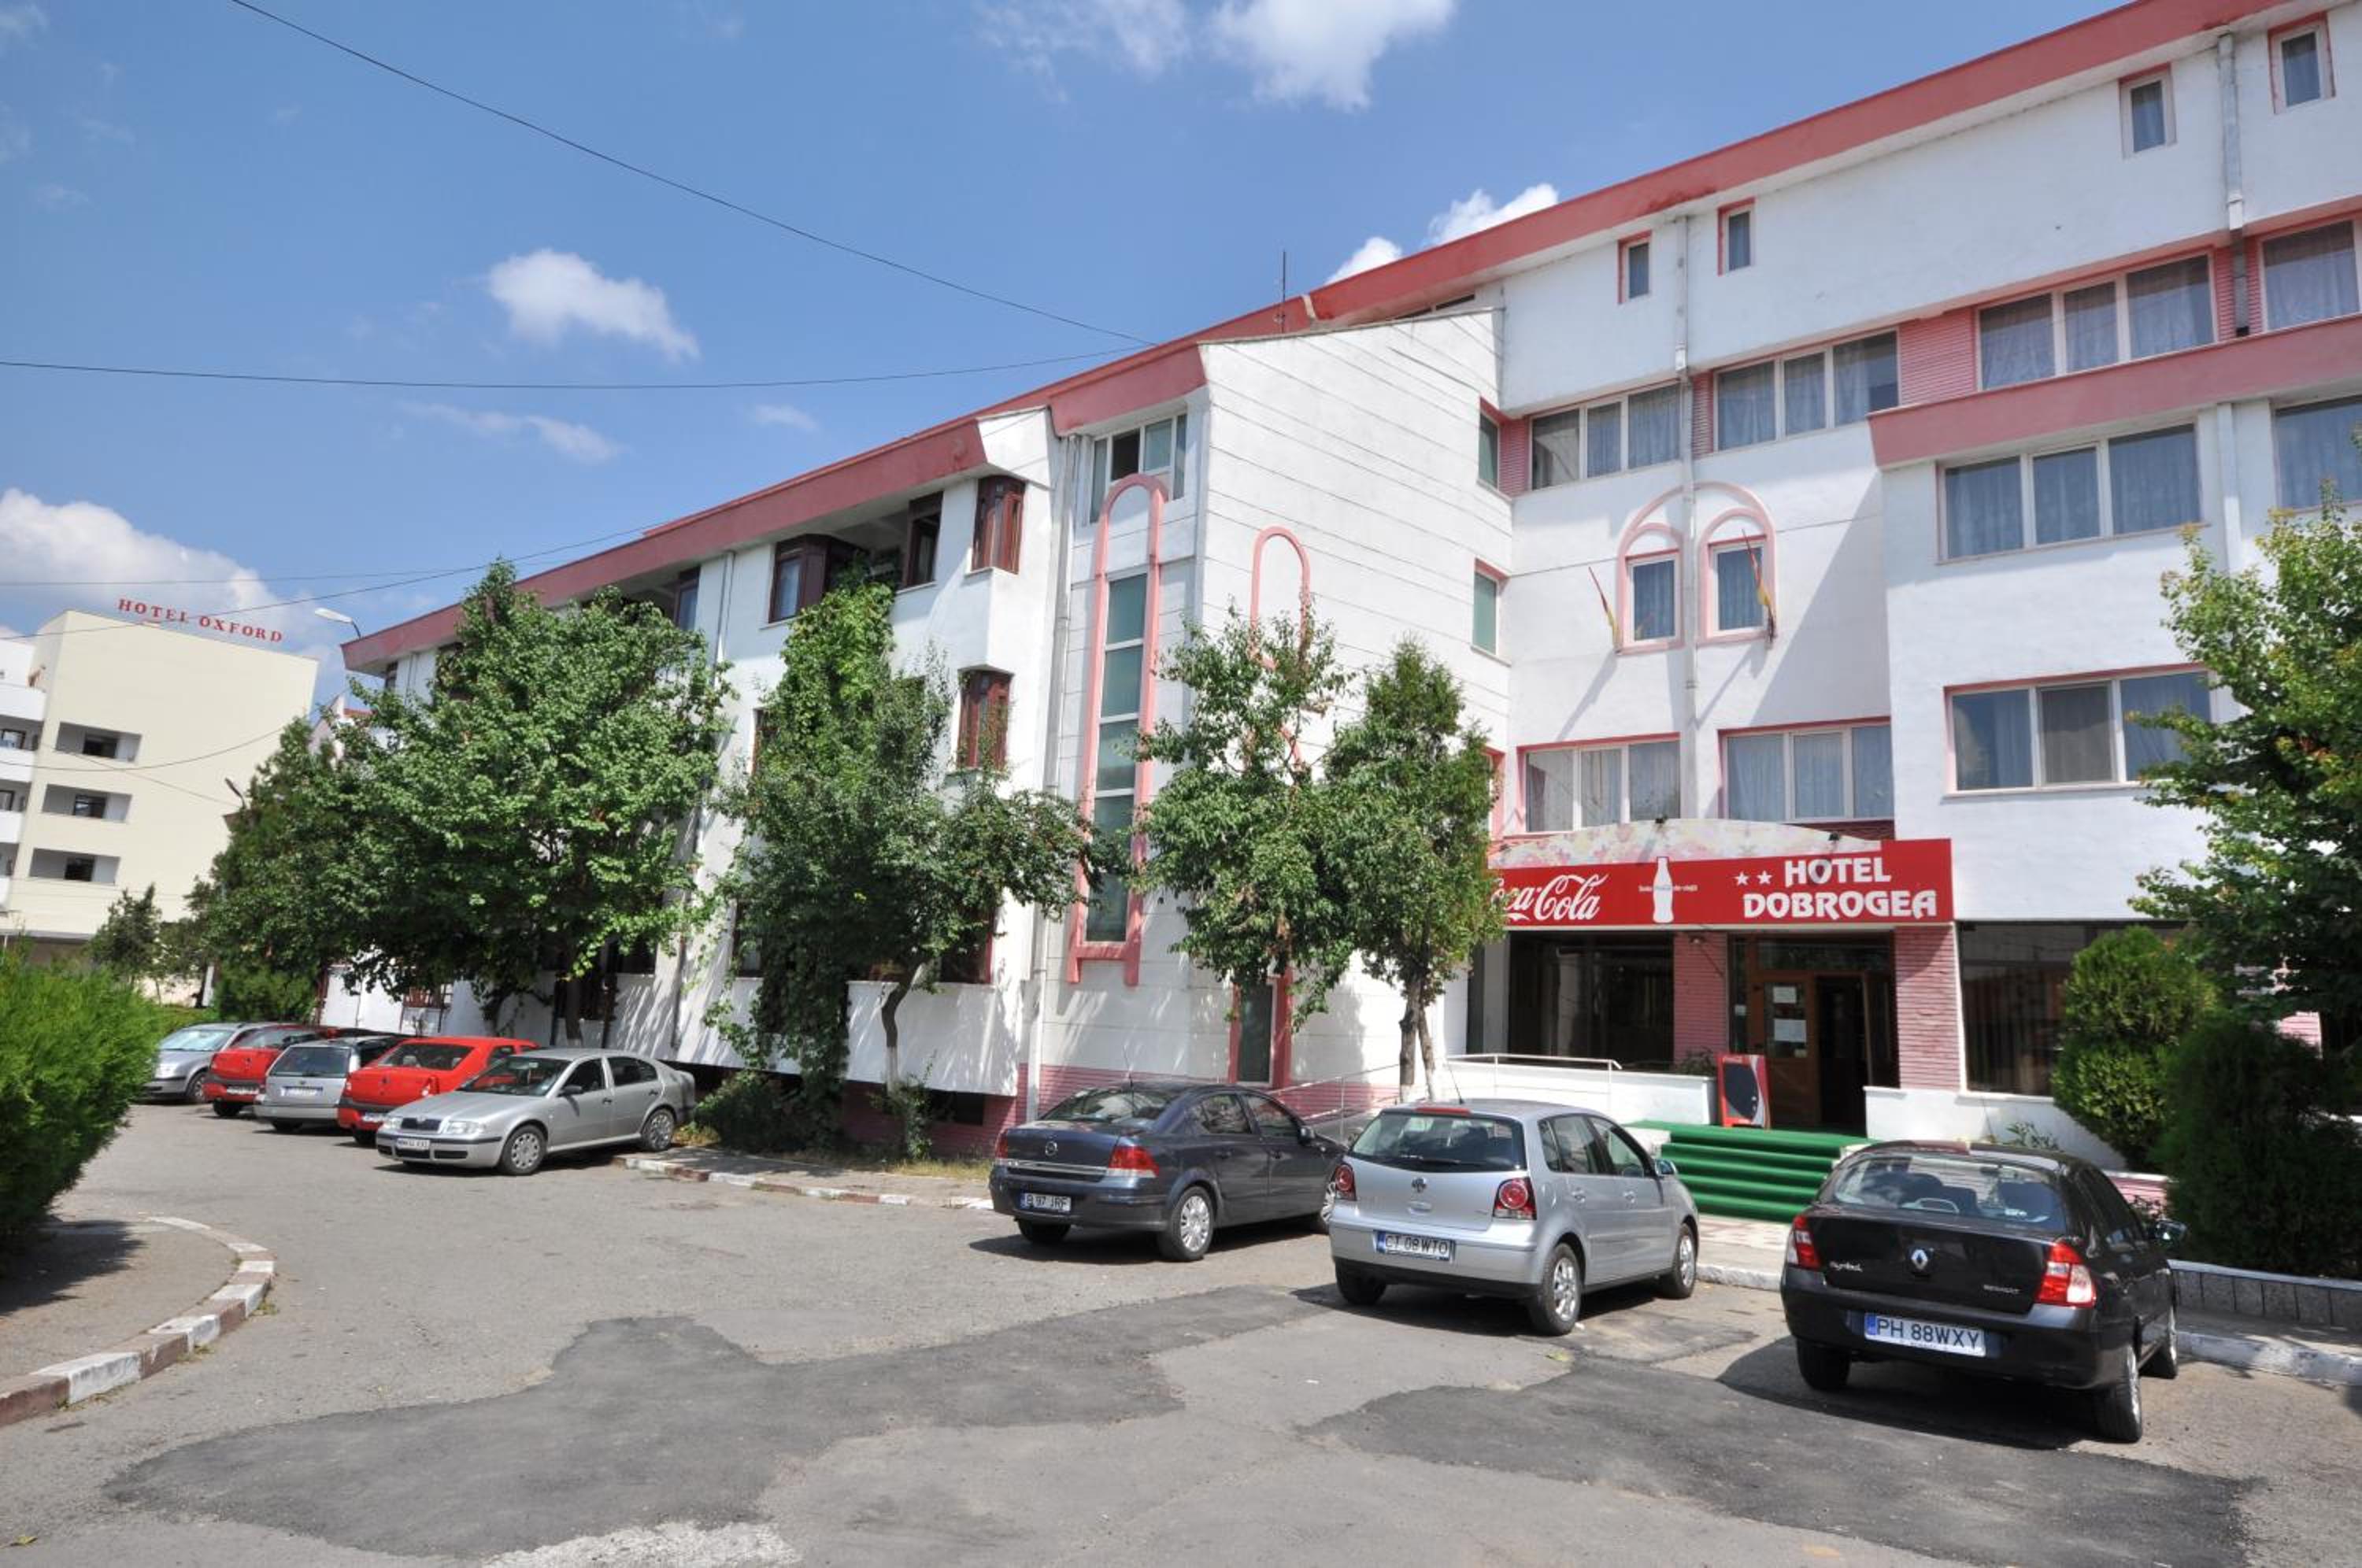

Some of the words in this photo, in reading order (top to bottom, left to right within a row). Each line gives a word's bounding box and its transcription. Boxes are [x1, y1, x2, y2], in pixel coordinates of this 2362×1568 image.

[118, 598, 188, 623] HOTEL
[199, 616, 283, 643] OXFORD
[1784, 857, 1892, 888] HOTEL
[1742, 889, 1938, 920] DOBROGEA
[1877, 1318, 1904, 1338] PH
